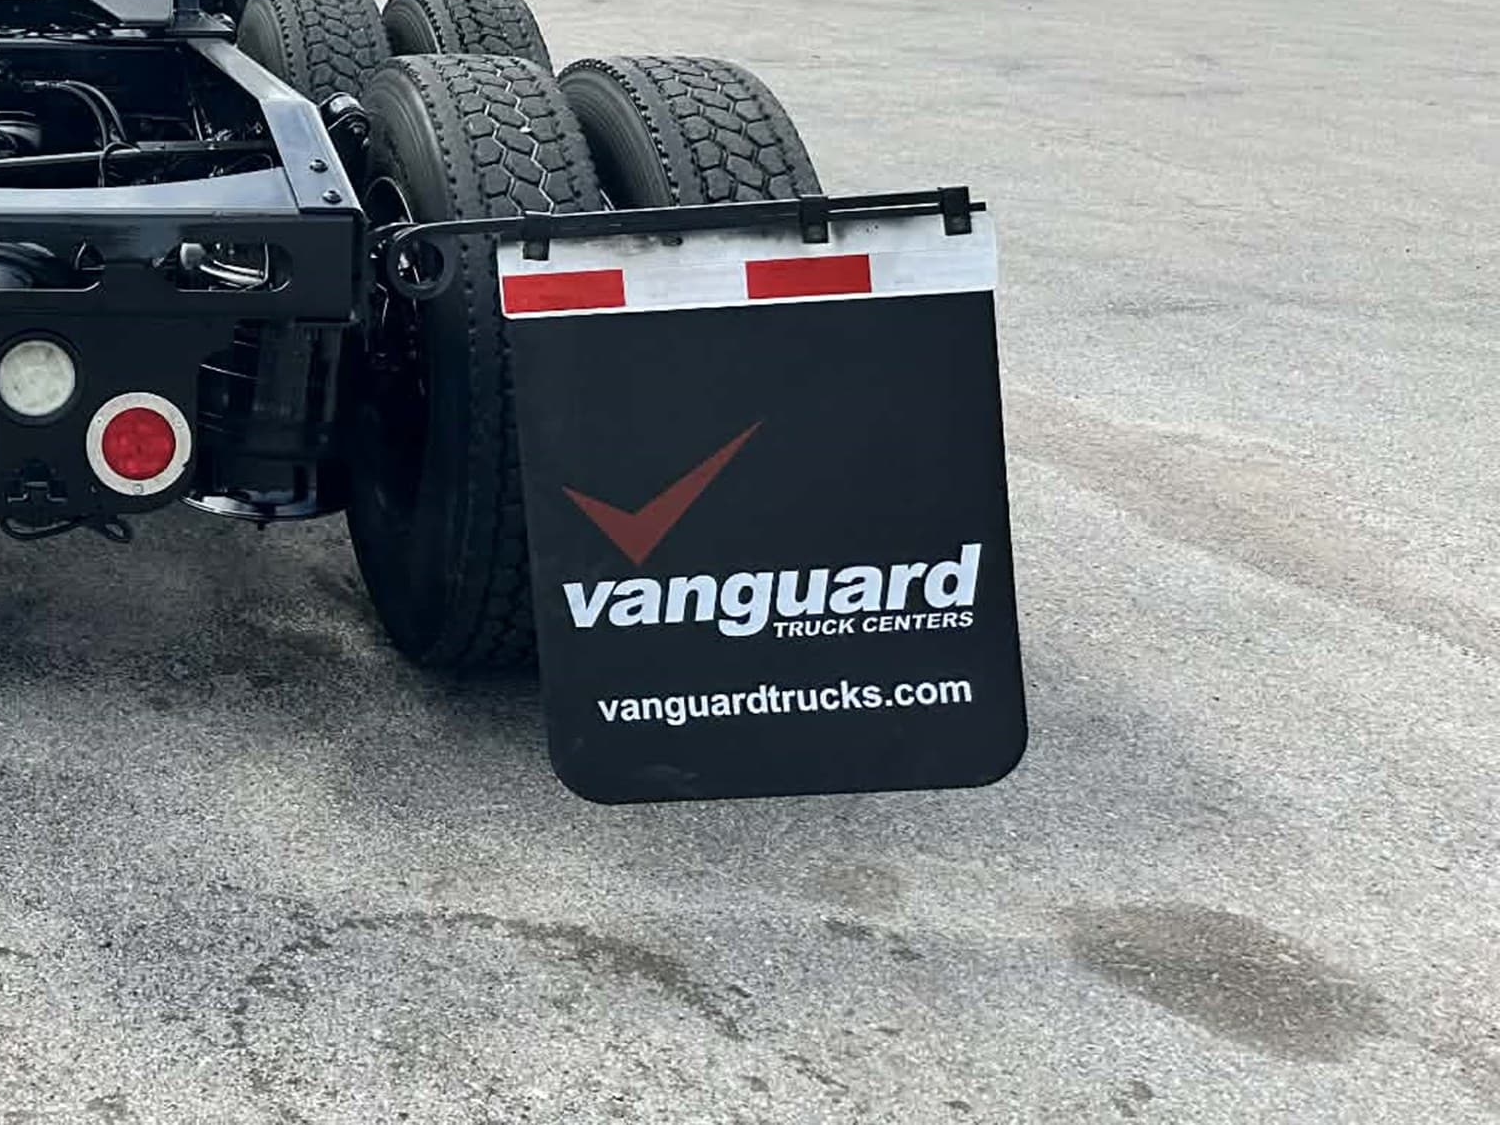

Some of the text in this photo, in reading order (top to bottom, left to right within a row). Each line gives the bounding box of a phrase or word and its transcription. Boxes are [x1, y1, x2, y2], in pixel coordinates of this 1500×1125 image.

[563, 543, 982, 638] vanguard
[773, 611, 974, 638] TRUCK CENTERS
[598, 679, 972, 725] vanguardtrucks.com
